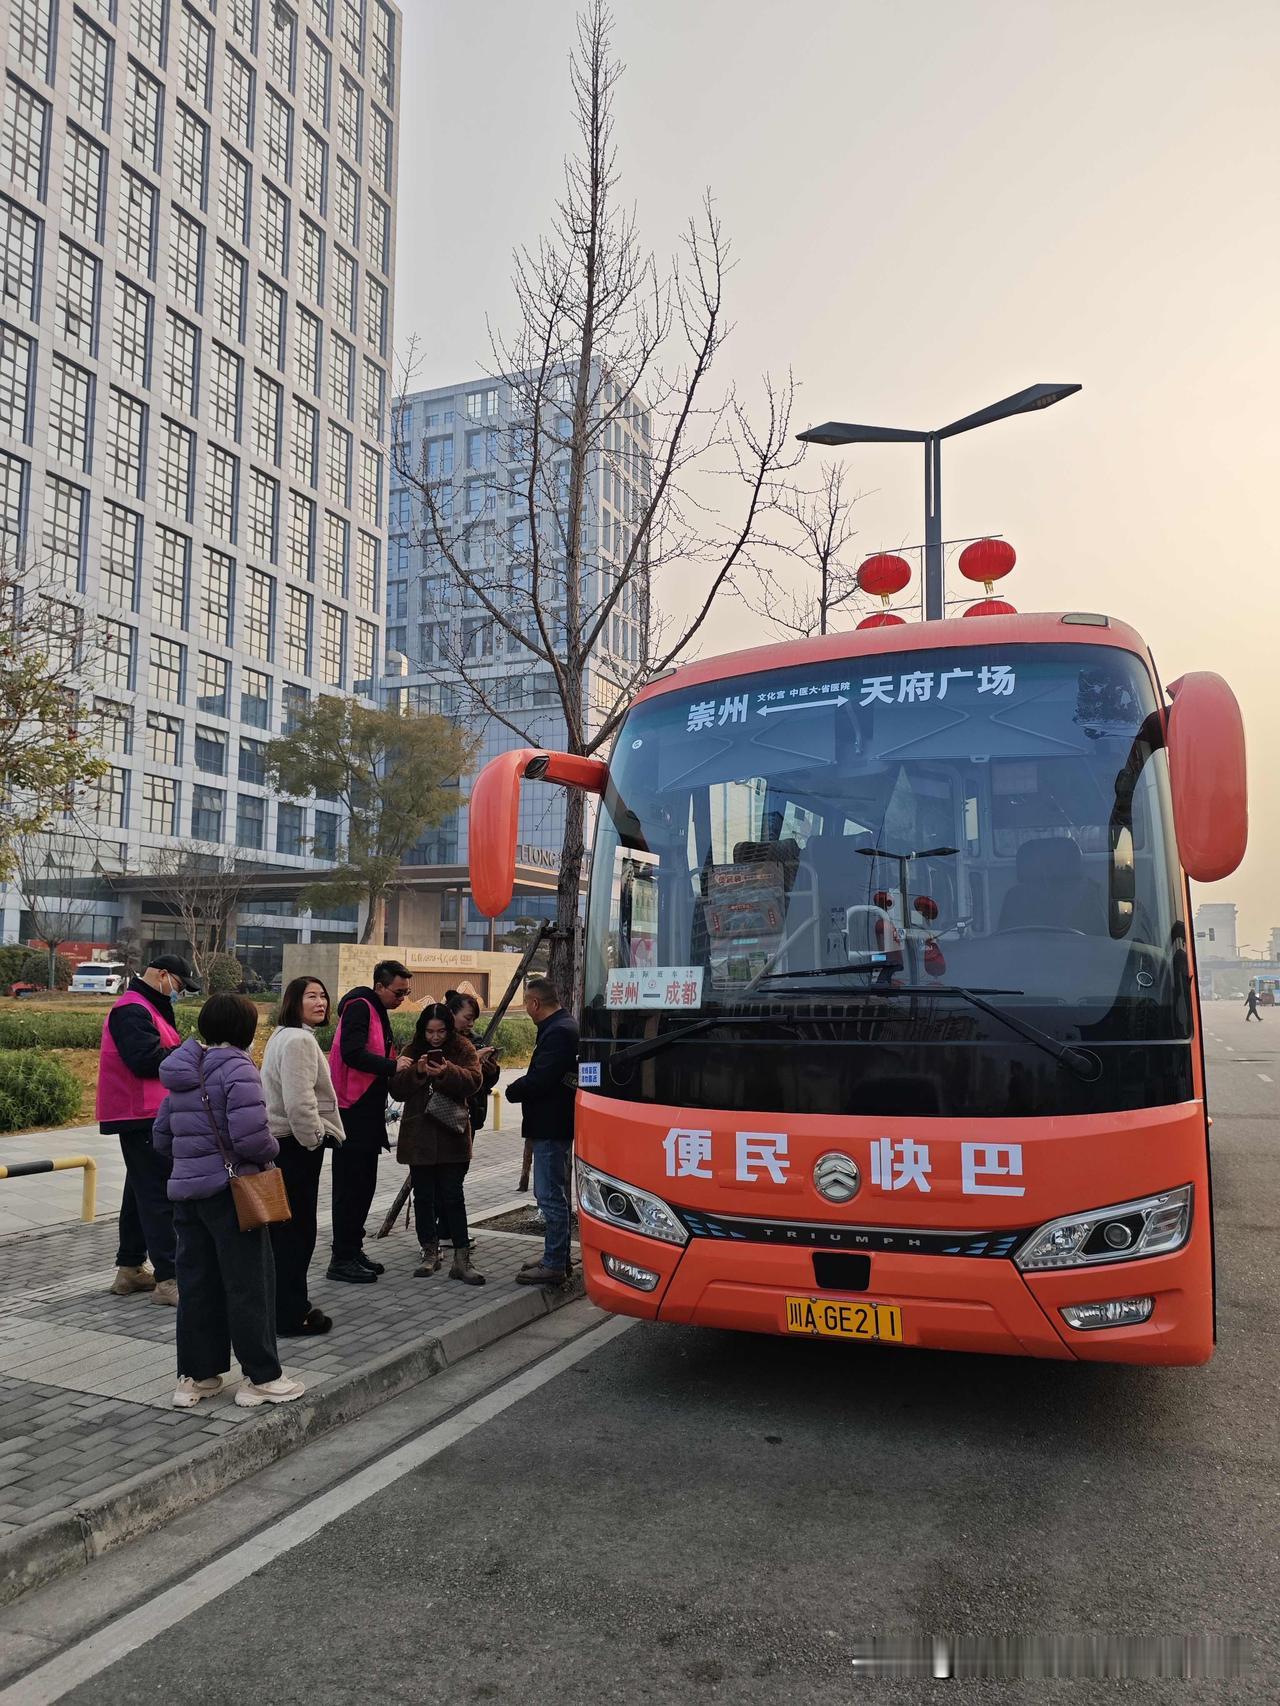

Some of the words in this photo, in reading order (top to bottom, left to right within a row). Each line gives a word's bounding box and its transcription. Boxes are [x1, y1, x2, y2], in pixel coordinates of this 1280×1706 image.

[686, 694, 749, 732] 崇州
[858, 665, 1016, 707] 天府广场
[757, 690, 785, 703] 文化宫
[763, 1229, 921, 1247] TRIUMPH
